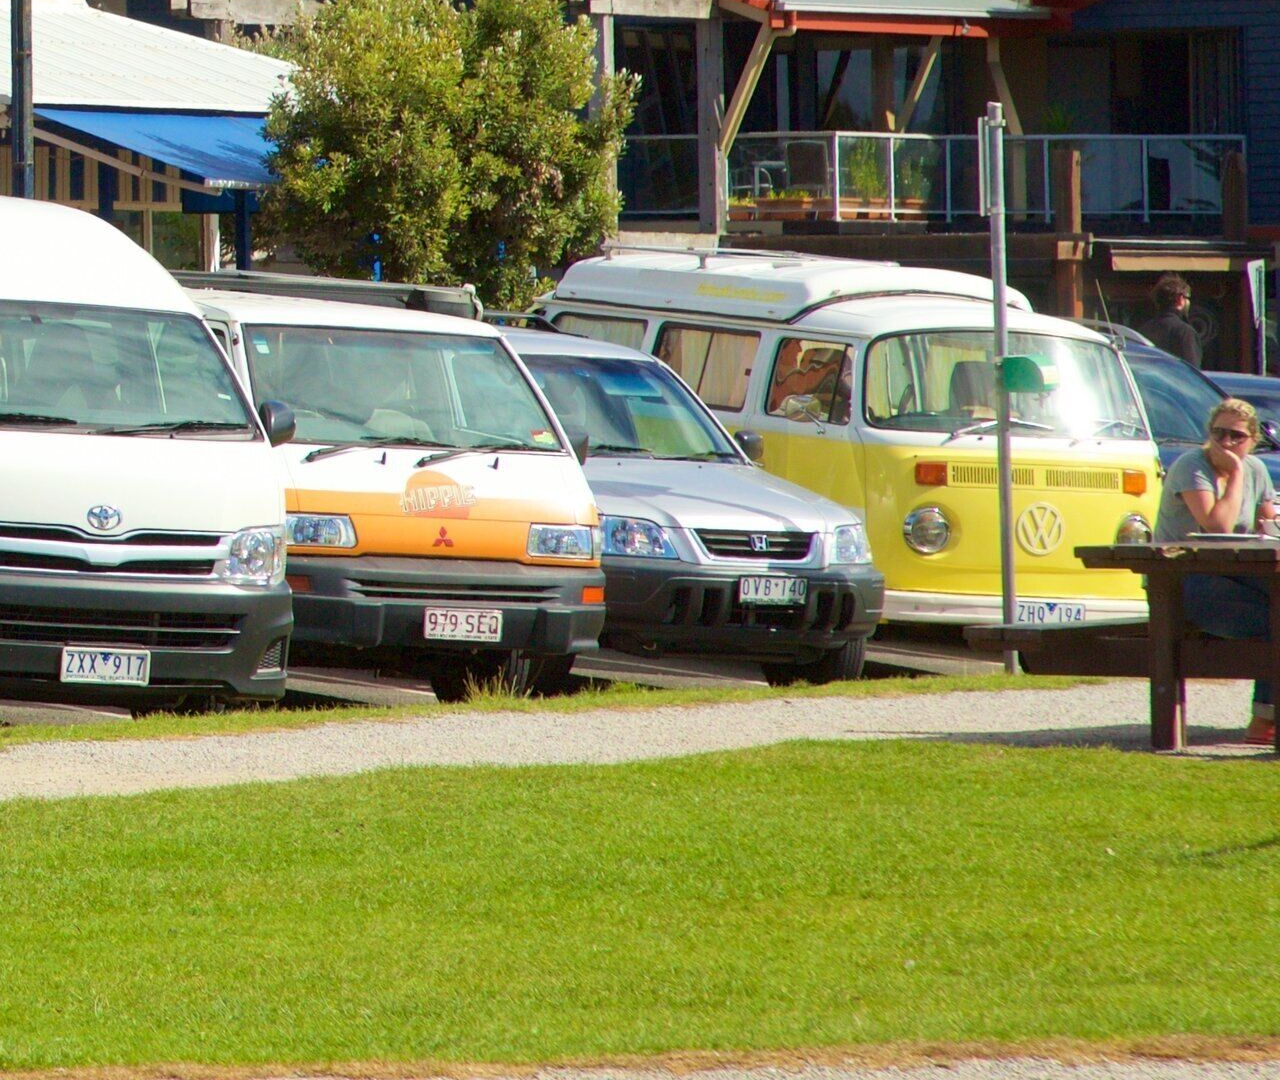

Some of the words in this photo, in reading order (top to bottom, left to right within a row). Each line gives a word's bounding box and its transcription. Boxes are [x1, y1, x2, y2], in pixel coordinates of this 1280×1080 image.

[781, 580, 806, 596] 140
[1018, 604, 1045, 623] ZHQ
[1059, 607, 1081, 623] 194
[66, 653, 97, 674] ZXX
[113, 655, 145, 676] 917
